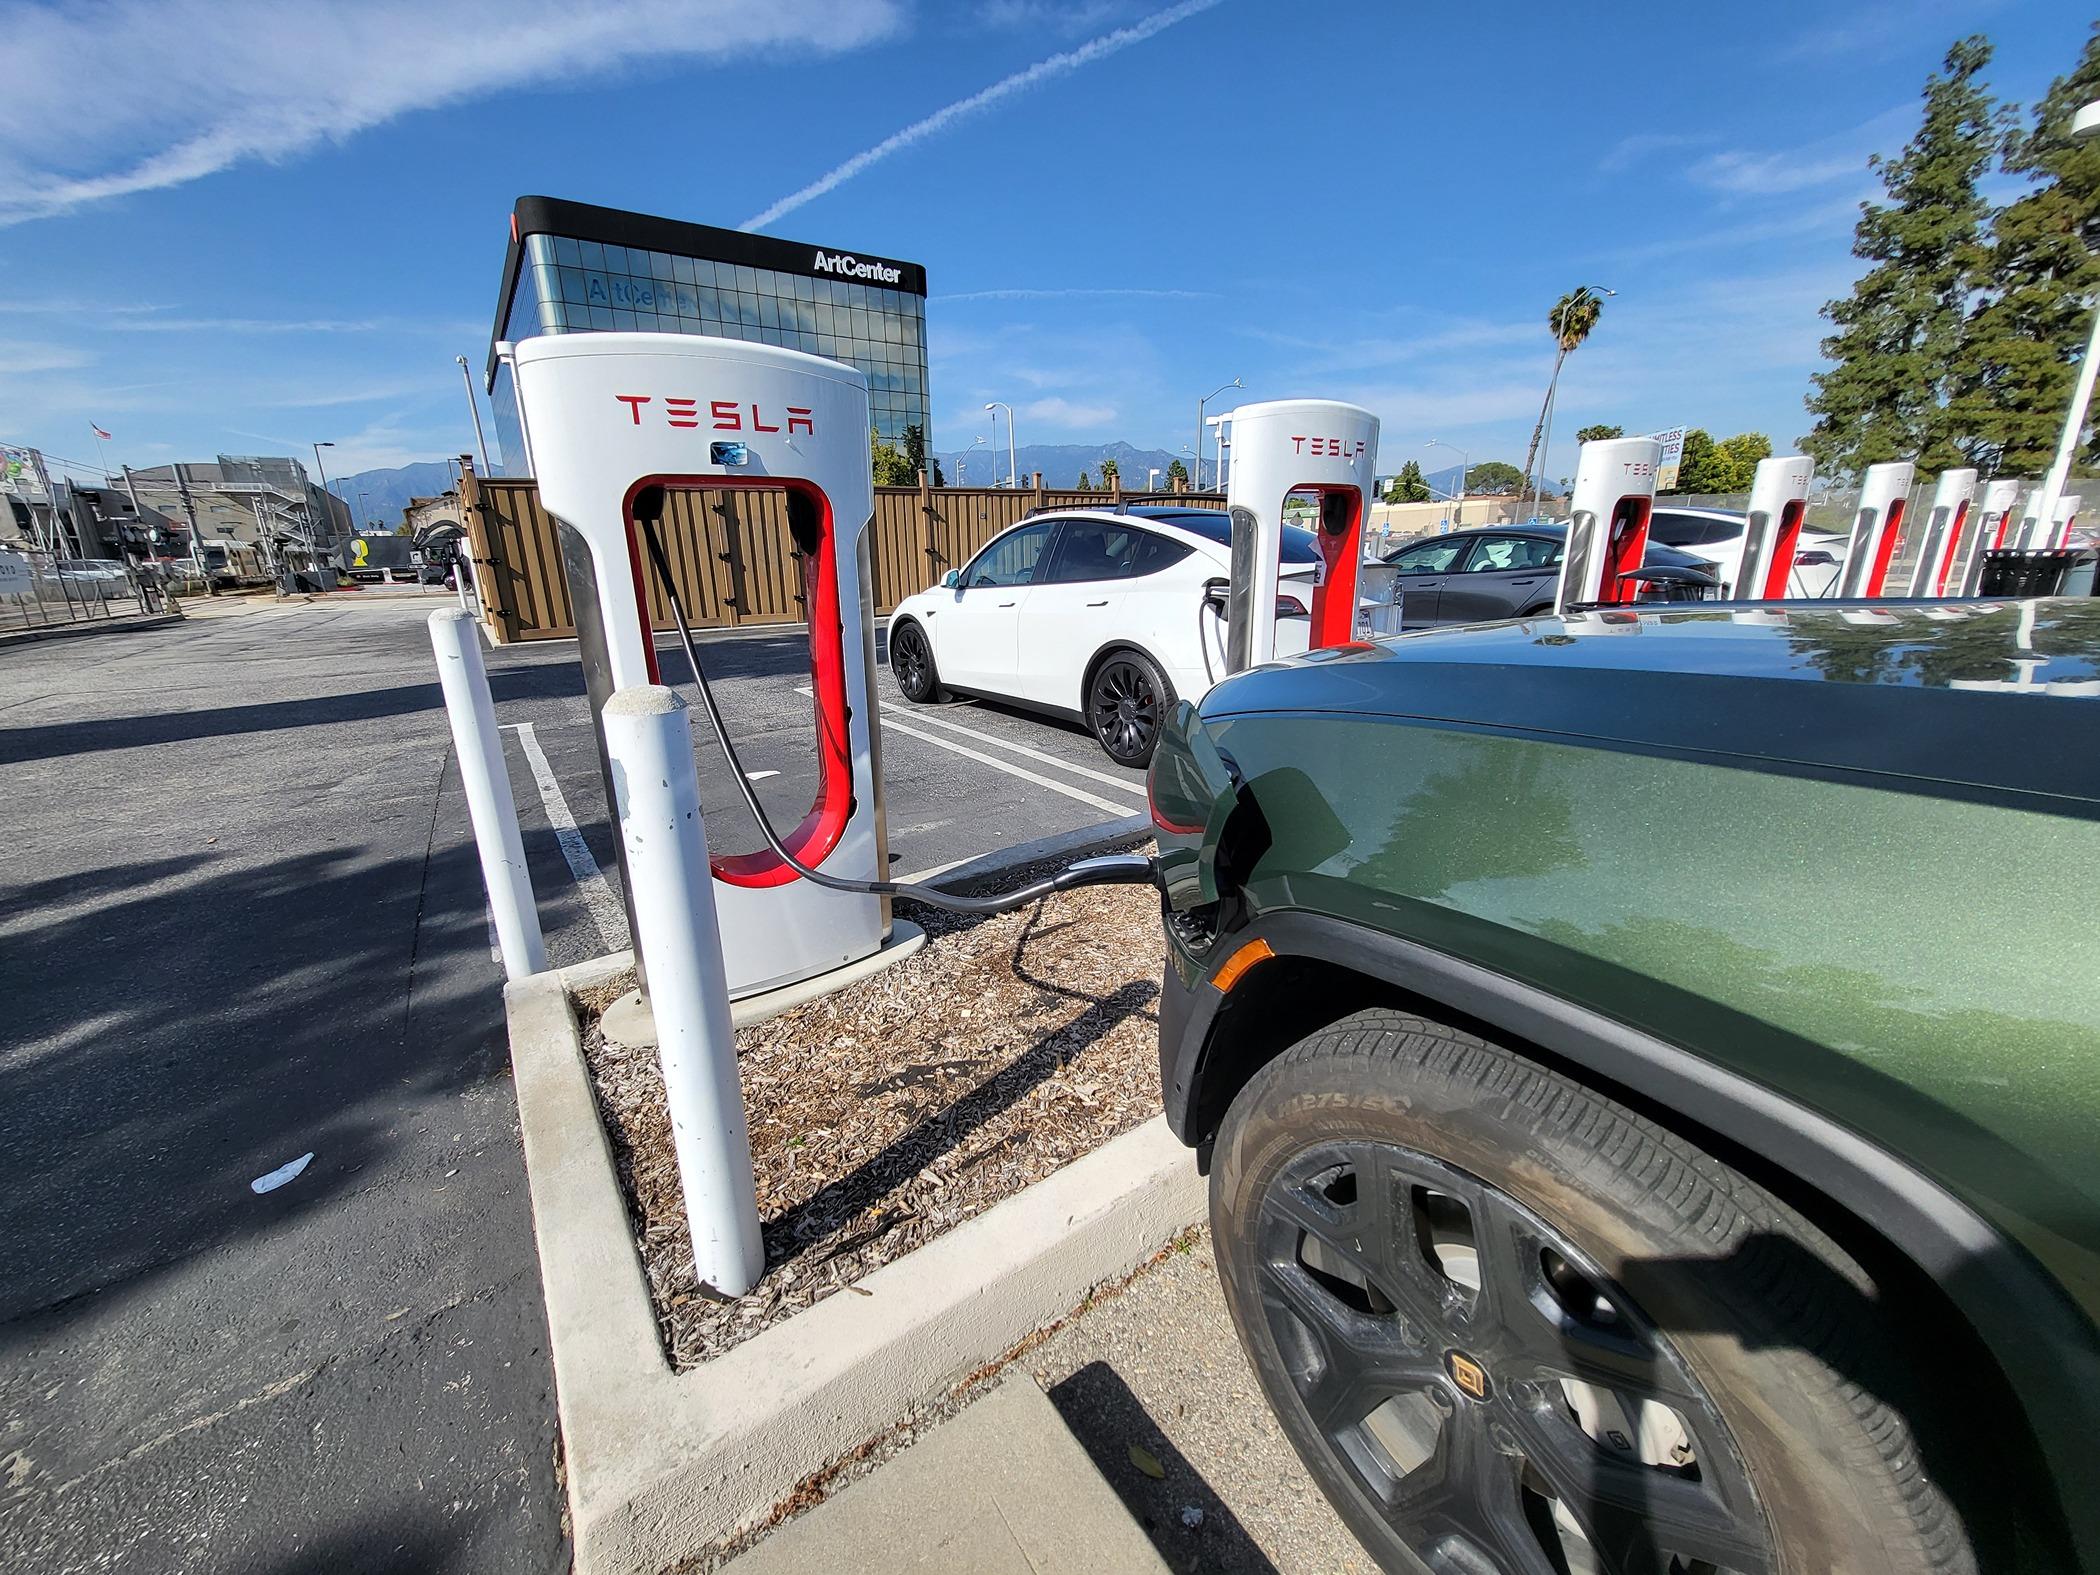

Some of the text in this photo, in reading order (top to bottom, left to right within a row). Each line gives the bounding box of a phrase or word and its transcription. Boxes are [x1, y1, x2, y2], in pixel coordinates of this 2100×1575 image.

[814, 251, 901, 283] ArtCenter
[615, 395, 814, 436] TESLA
[1291, 436, 1366, 459] TESLA
